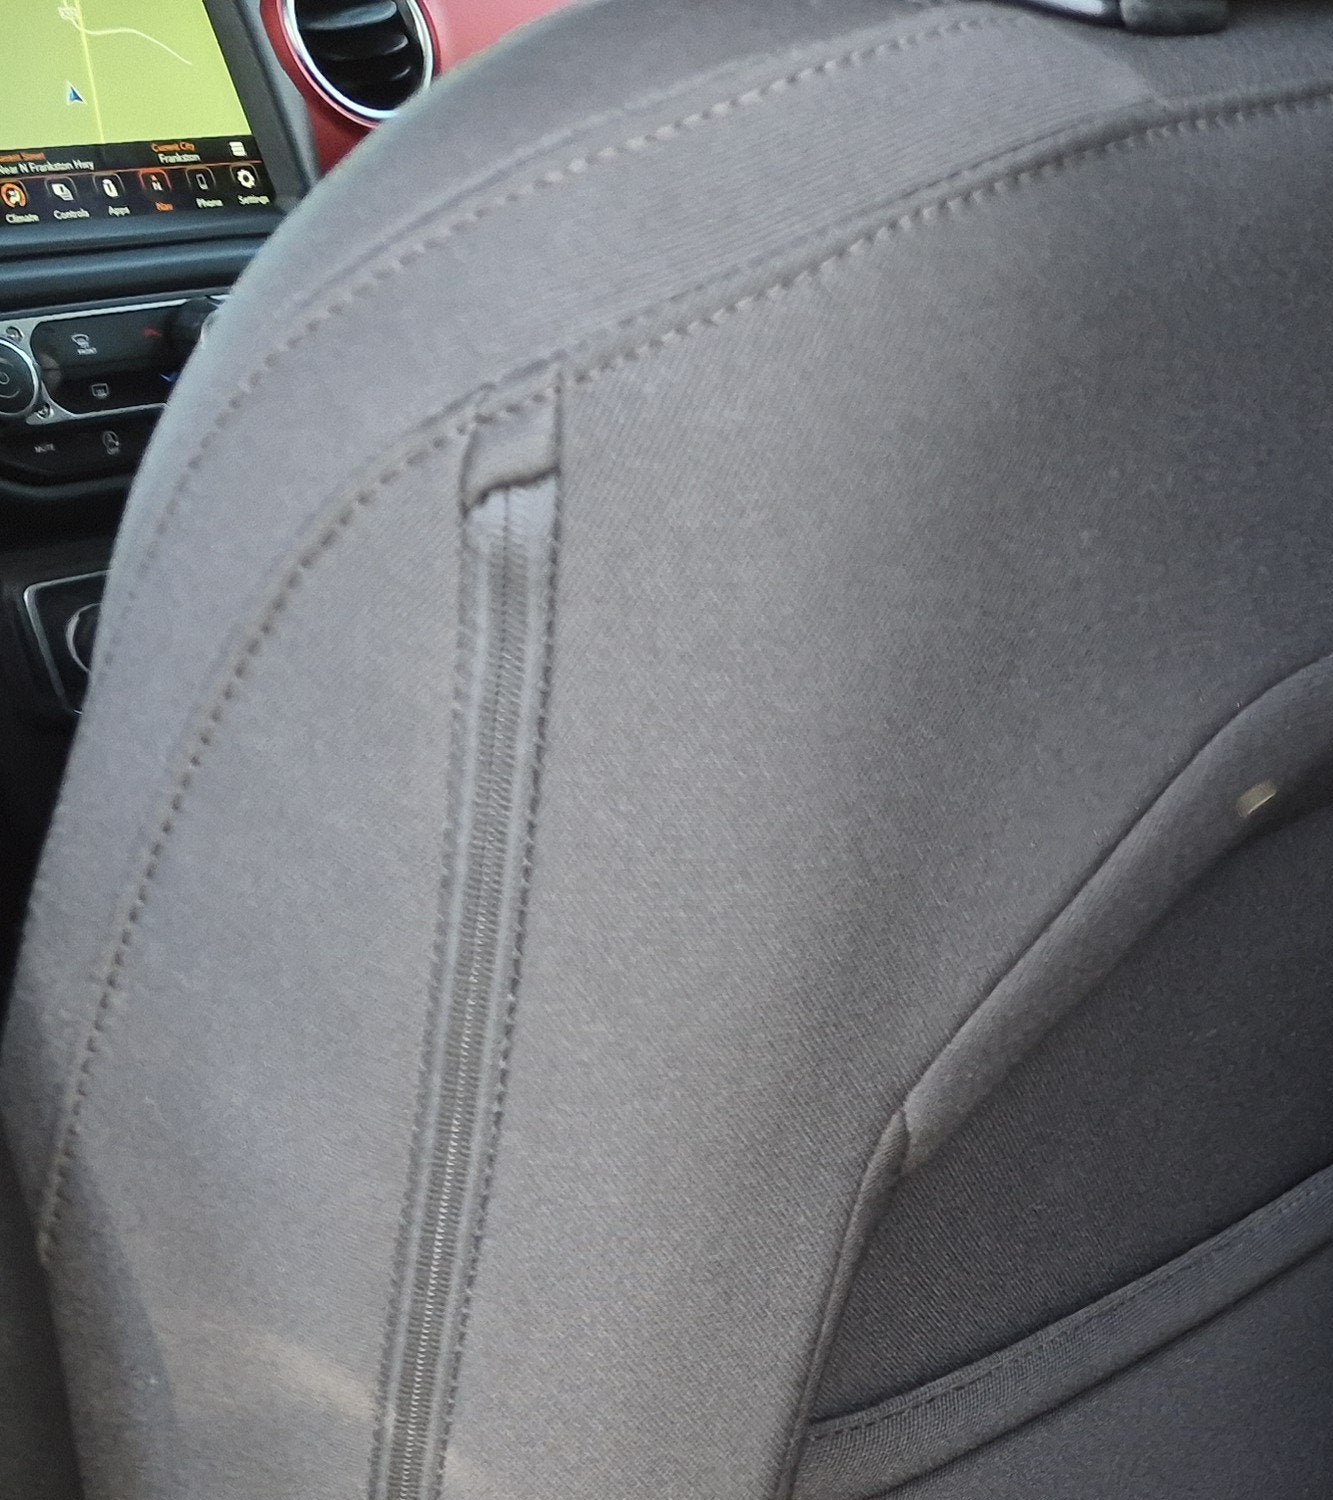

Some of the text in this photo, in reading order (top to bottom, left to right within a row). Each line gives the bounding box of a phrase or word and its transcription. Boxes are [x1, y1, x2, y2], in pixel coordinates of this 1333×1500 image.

[28, 160, 74, 173] Frankston
[72, 159, 95, 171] Hwy
[53, 207, 90, 220] Controls
[108, 205, 131, 217] Apps
